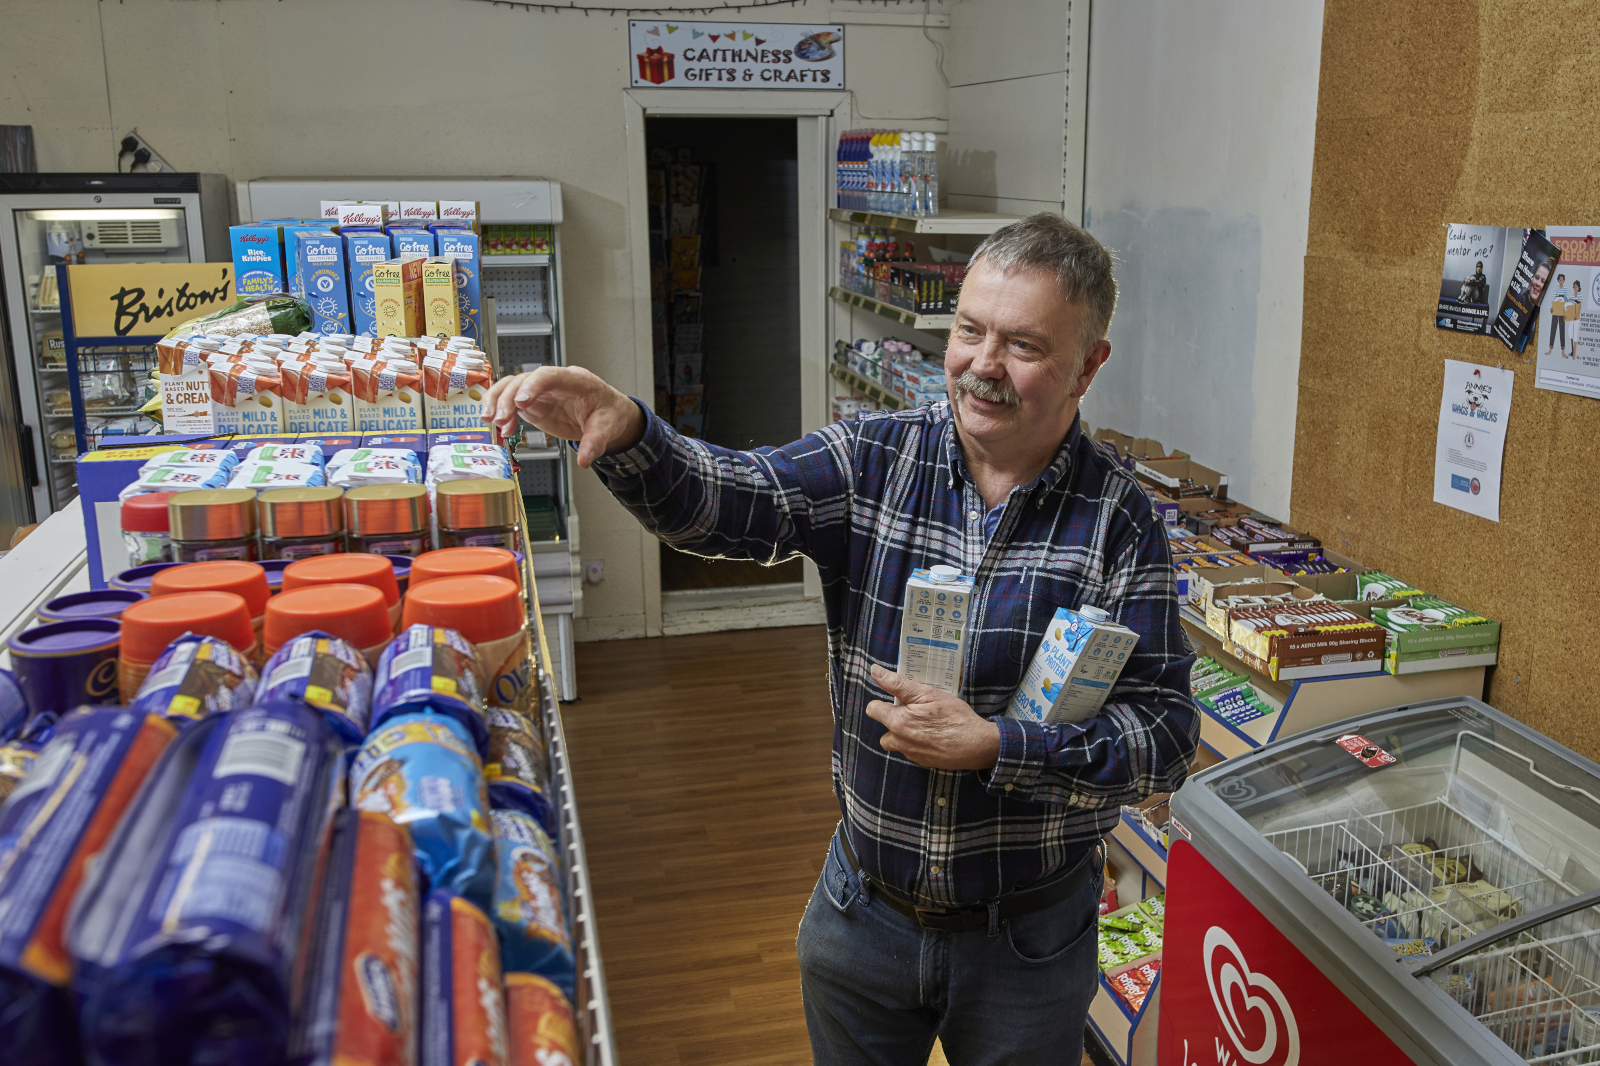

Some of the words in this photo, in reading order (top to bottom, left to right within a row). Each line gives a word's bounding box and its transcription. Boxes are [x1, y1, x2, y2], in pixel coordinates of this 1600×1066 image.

[682, 48, 793, 64] CAITHNESS
[684, 67, 736, 82] GIFTS
[742, 69, 754, 81] &
[760, 68, 831, 83] CRAFTS
[404, 207, 435, 218] Kellogg's
[444, 207, 474, 218] Kellogg's
[343, 213, 381, 224] Kellogg's
[240, 234, 269, 244] Kellogg's
[1449, 229, 1466, 240] Could
[1469, 234, 1481, 244] you
[306, 246, 319, 255] Go
[318, 245, 337, 255] free
[355, 247, 368, 256] Go
[367, 245, 385, 255] free
[400, 243, 413, 252] Go
[412, 242, 429, 252] free
[444, 243, 457, 253] Go
[456, 242, 473, 253] free
[1447, 245, 1471, 256] mentor
[1474, 244, 1494, 258] me?
[1556, 240, 1586, 250] FOOD
[1589, 241, 1600, 252] BA
[1522, 251, 1534, 266] Share
[1560, 250, 1600, 262] REFERRA
[385, 269, 400, 278] free
[409, 261, 421, 280] NEW
[435, 269, 450, 277] free
[243, 277, 273, 285] FAMILY'S
[186, 381, 209, 391] NUT
[166, 393, 174, 404] &
[313, 408, 337, 419] MILD
[340, 408, 347, 418] &
[383, 407, 406, 417] MILD
[409, 407, 416, 417] &
[453, 405, 476, 415] MILD
[1452, 403, 1468, 416] WAGS
[1477, 409, 1498, 423] WALKS
[242, 411, 267, 422] MILD
[270, 411, 277, 422] &
[218, 424, 278, 434] DELICATE
[290, 421, 348, 433] DELICATE
[360, 420, 417, 431] DELICATE
[1339, 639, 1358, 647] Sharing
[1051, 645, 1072, 669] PLANT
[1045, 655, 1066, 679] PROTEIN
[1220, 700, 1244, 712] POLO
